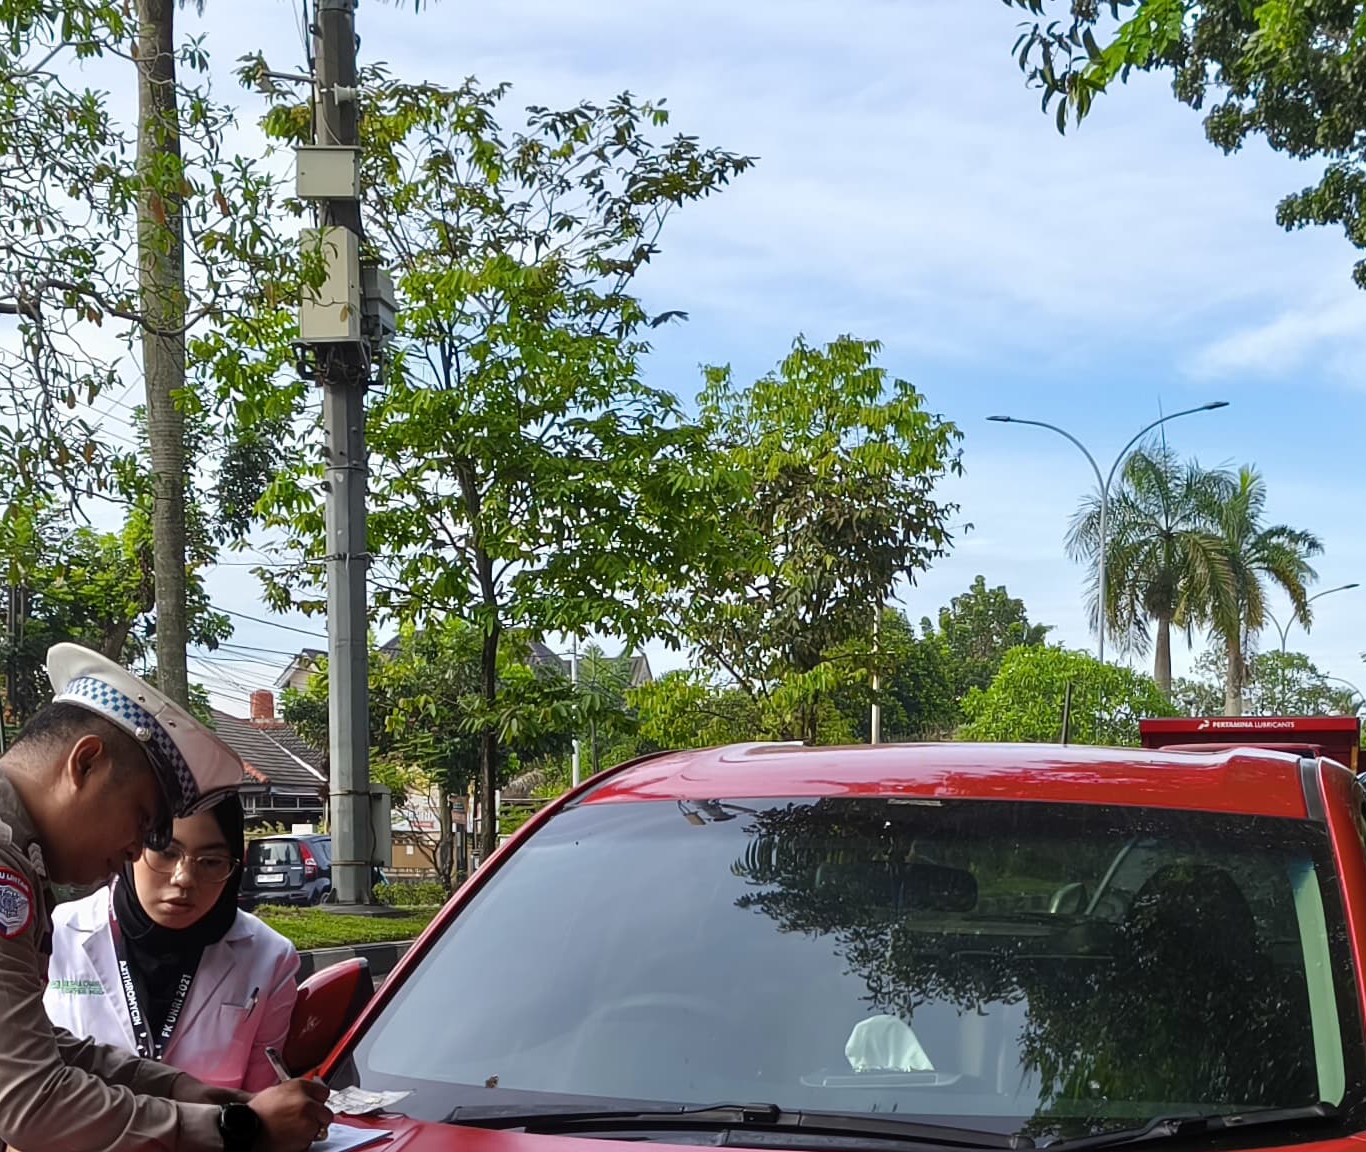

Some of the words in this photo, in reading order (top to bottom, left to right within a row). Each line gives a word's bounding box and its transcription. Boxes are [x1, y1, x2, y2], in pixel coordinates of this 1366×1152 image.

[1212, 721, 1253, 729] PERTAMINA
[1254, 721, 1295, 729] LUBRICANTS
[119, 960, 143, 1026] AZITHROMYCIN
[161, 1024, 173, 1038] FK
[167, 997, 183, 1022] UNRI
[176, 974, 192, 997] 2021
